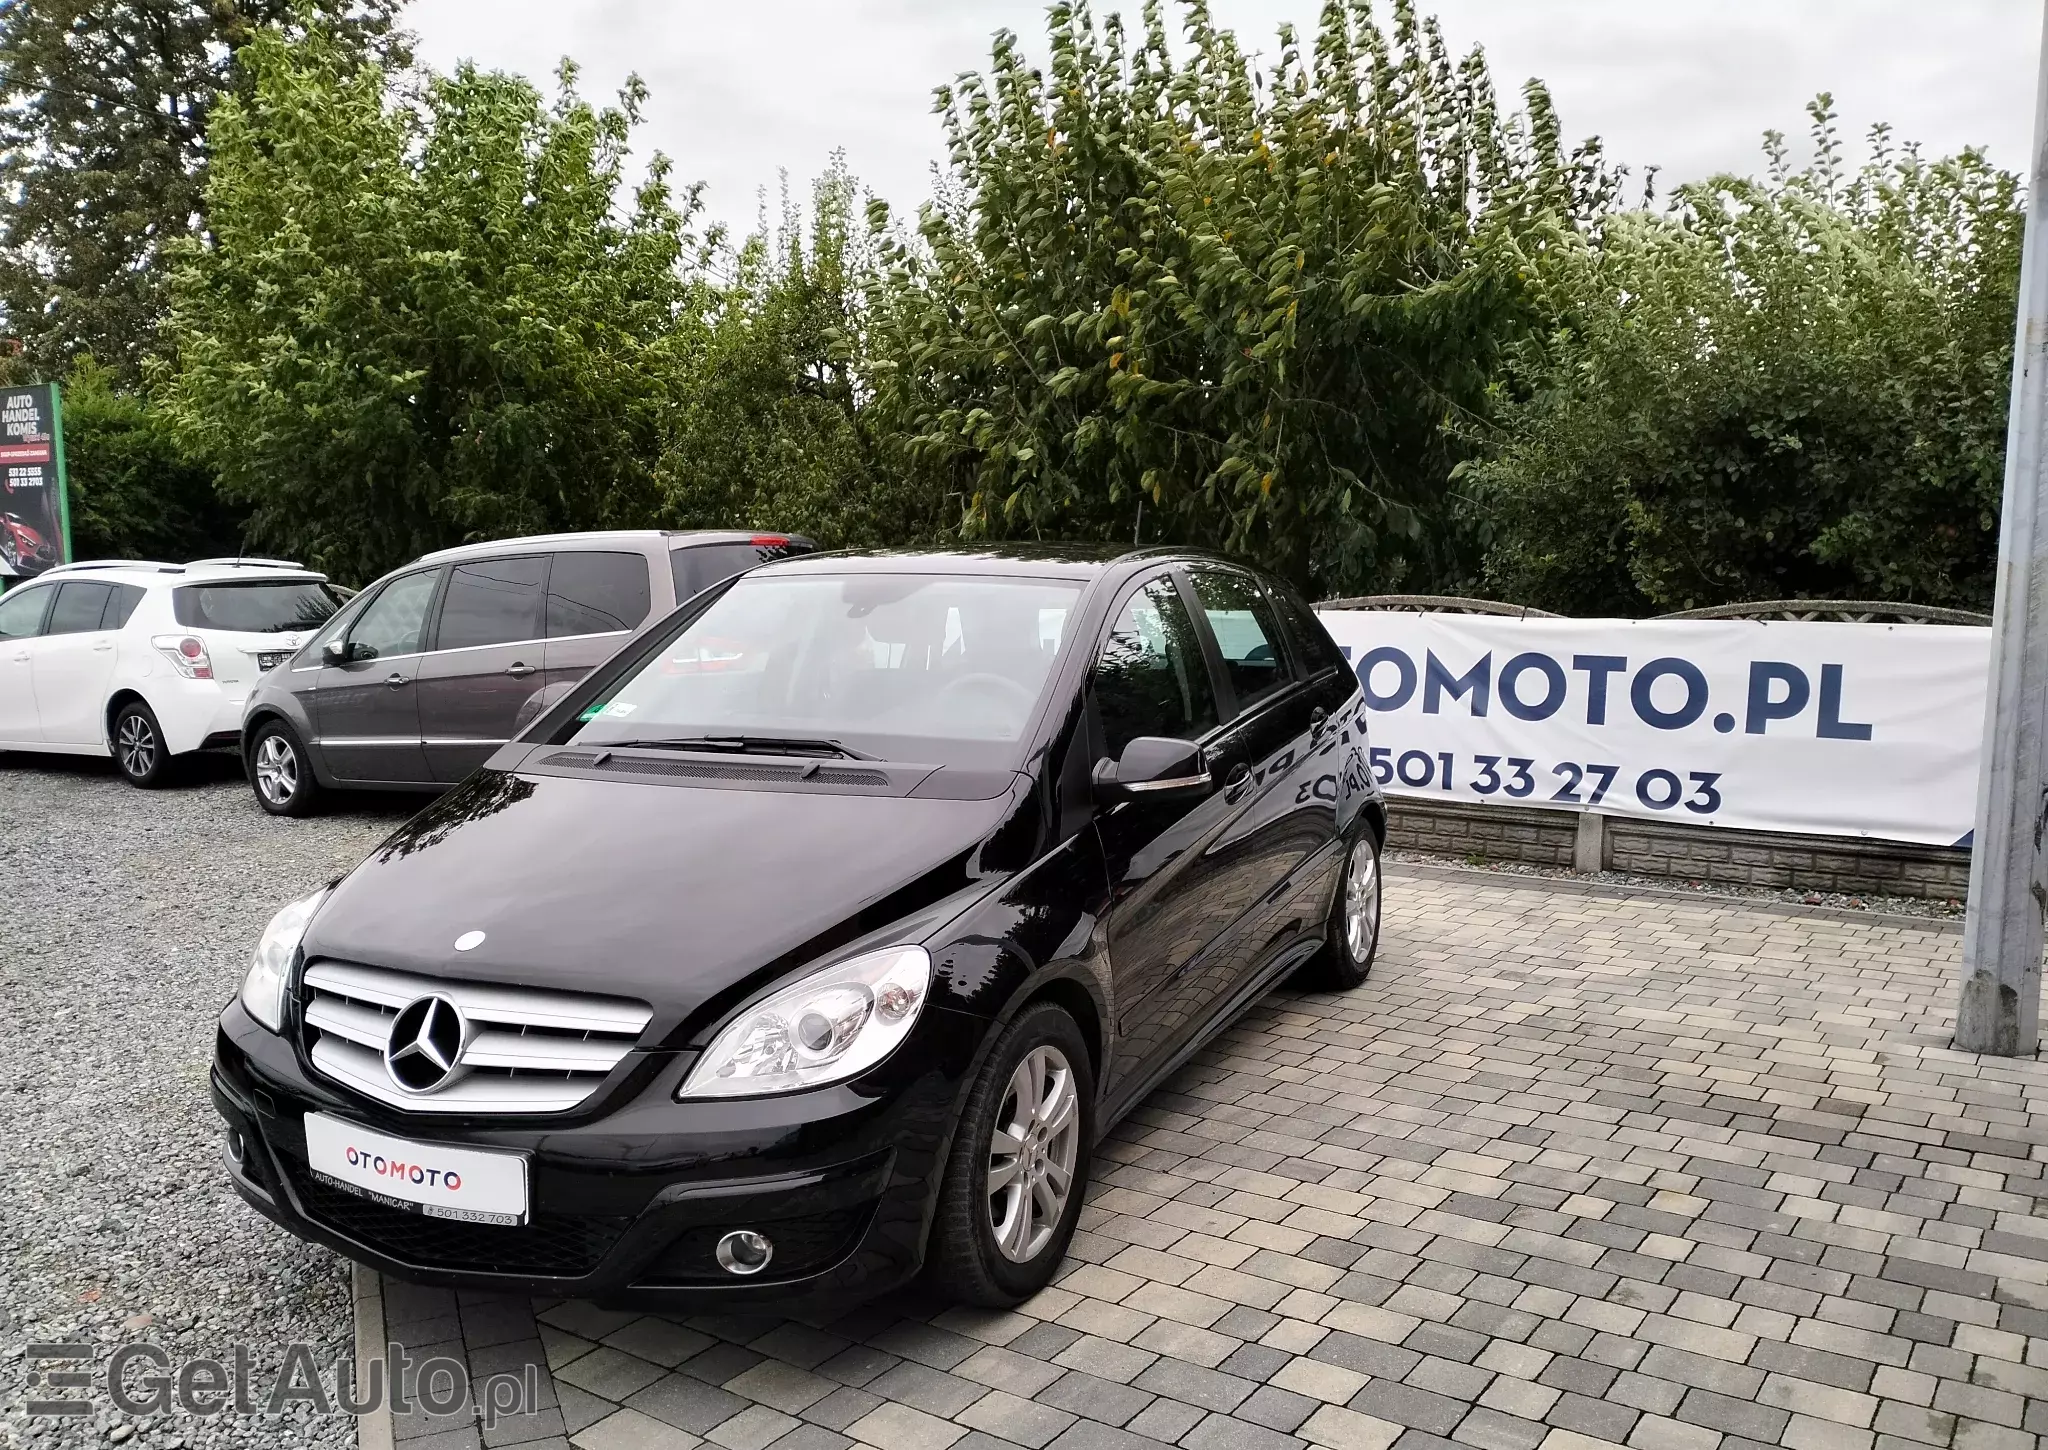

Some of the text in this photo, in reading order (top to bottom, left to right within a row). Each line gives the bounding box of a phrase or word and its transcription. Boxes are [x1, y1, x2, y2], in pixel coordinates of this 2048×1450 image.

[1, 408, 40, 423] HANDEL
[7, 394, 33, 409] AUTO
[6, 421, 38, 436] KOMIS
[1339, 645, 1873, 741] OMOTO.PL
[1369, 746, 1723, 814] 501 33 27 03
[345, 1146, 462, 1191] OTOMOTO
[315, 1172, 363, 1197] AUTO-HANDEL
[436, 1208, 459, 1220] 501
[461, 1210, 486, 1223] 332
[488, 1213, 513, 1225] 703
